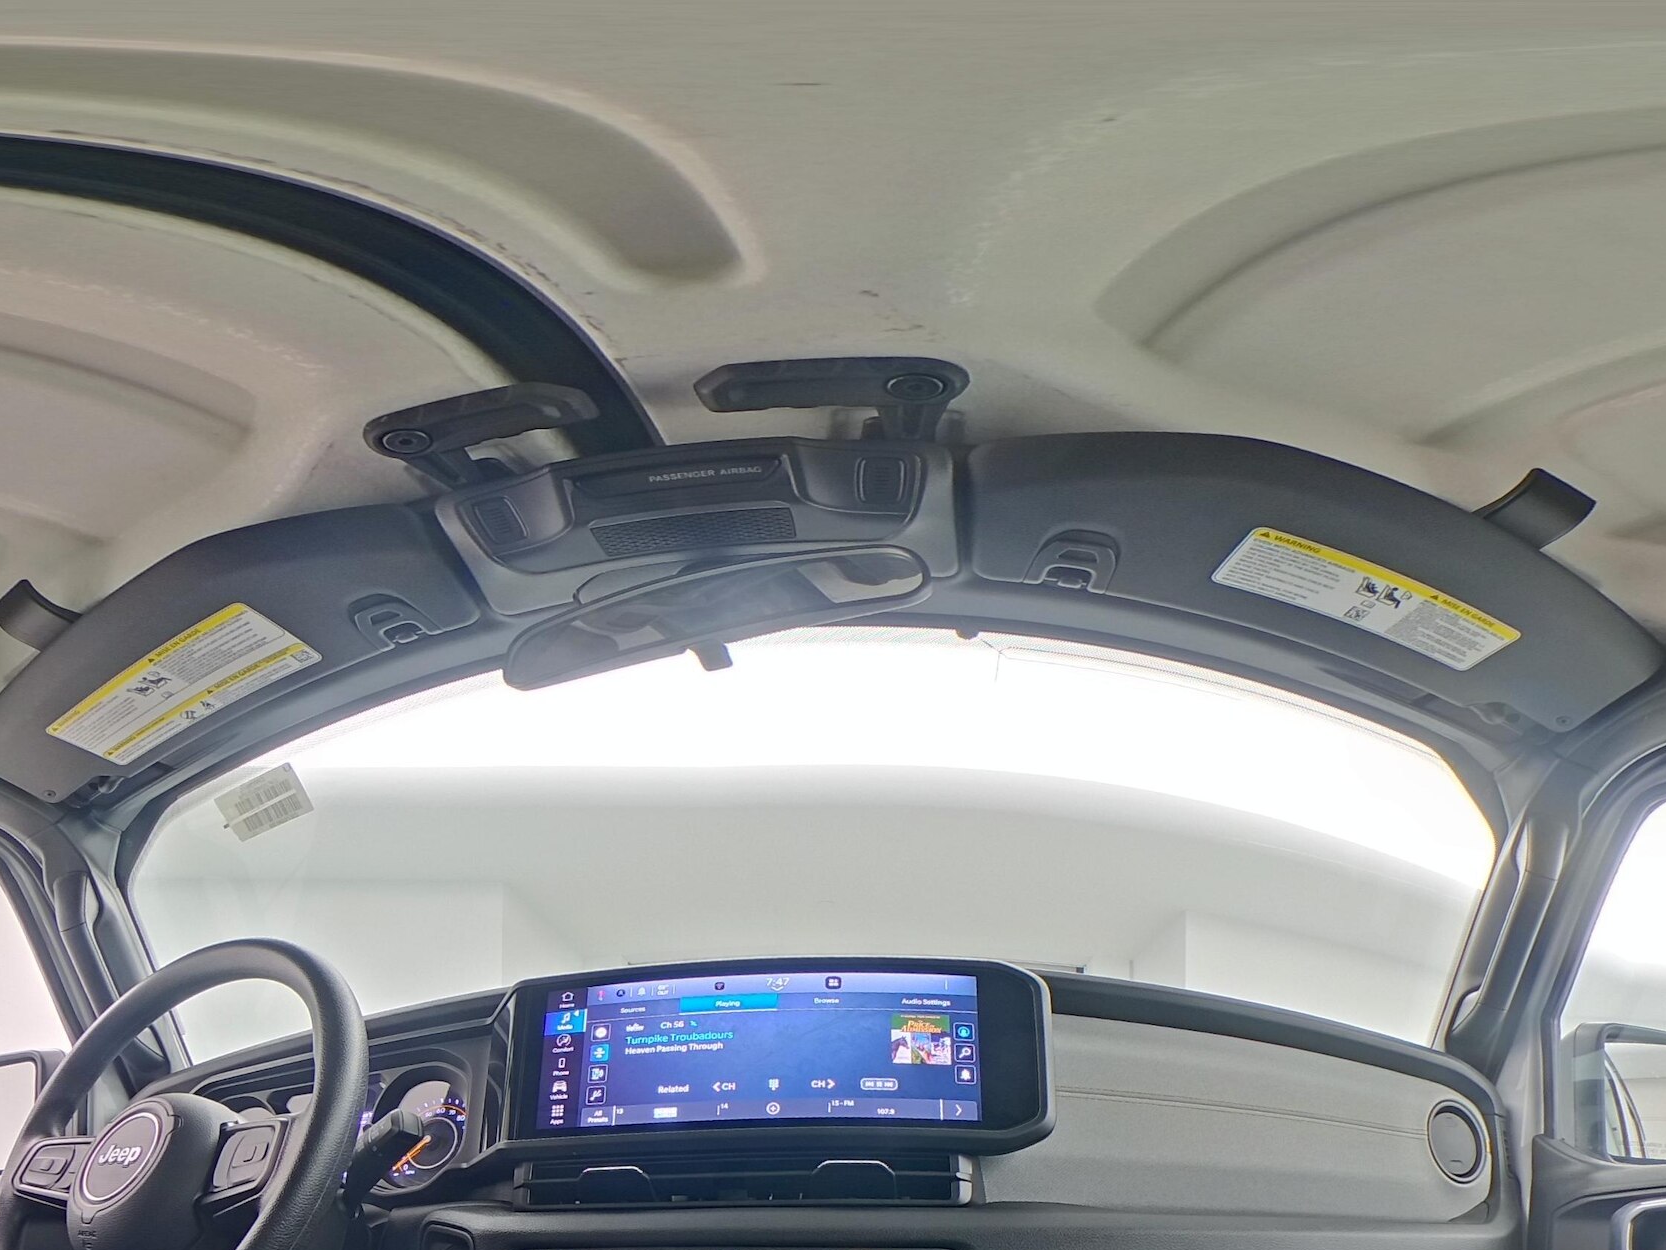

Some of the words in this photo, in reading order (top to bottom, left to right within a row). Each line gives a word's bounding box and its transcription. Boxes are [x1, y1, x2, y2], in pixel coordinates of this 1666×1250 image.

[649, 469, 715, 482] PASSENGER
[720, 466, 762, 476] AIRBAG
[1274, 535, 1321, 554] WARNING
[766, 977, 790, 987] 7:47
[715, 1000, 741, 1008] Playing
[813, 996, 840, 1004] Browse
[922, 998, 951, 1007] Settings
[620, 1006, 646, 1014] Sources
[660, 1021, 672, 1029] Ch
[673, 1020, 684, 1028] 56
[626, 1033, 669, 1045] Turnpike
[671, 1030, 734, 1041] Troubadours
[625, 1046, 655, 1055] Heaven
[656, 1044, 687, 1053] Passing
[688, 1041, 724, 1051] Through
[721, 1082, 736, 1091] CH
[811, 1080, 825, 1088] CH
[658, 1084, 689, 1094] Related
[550, 1118, 564, 1126] Apps
[98, 1144, 142, 1167] Jeep
